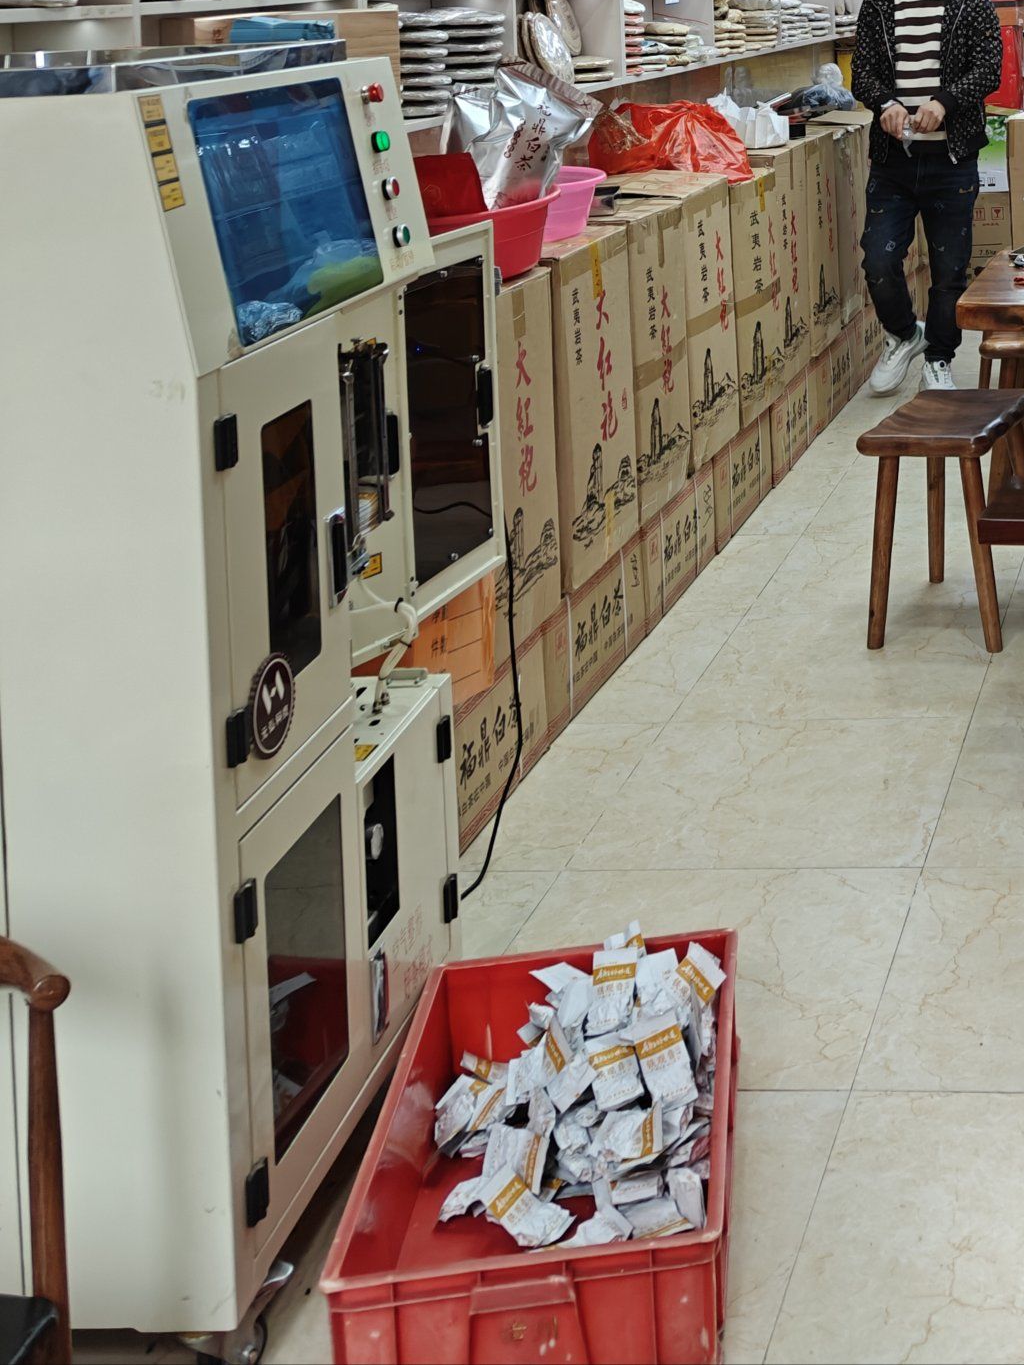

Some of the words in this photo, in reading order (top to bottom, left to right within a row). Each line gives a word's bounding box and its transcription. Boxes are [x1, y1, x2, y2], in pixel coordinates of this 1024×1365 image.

[697, 219, 710, 304] 武夷岩茶
[749, 210, 764, 295] 武夷岩茶
[571, 287, 583, 366] 武夷岩茶
[647, 266, 658, 340] 武夷岩茶
[663, 507, 699, 566] 福鼎白茶
[574, 578, 624, 661] 福鼎白茶
[459, 695, 521, 791] 福鼎白茶
